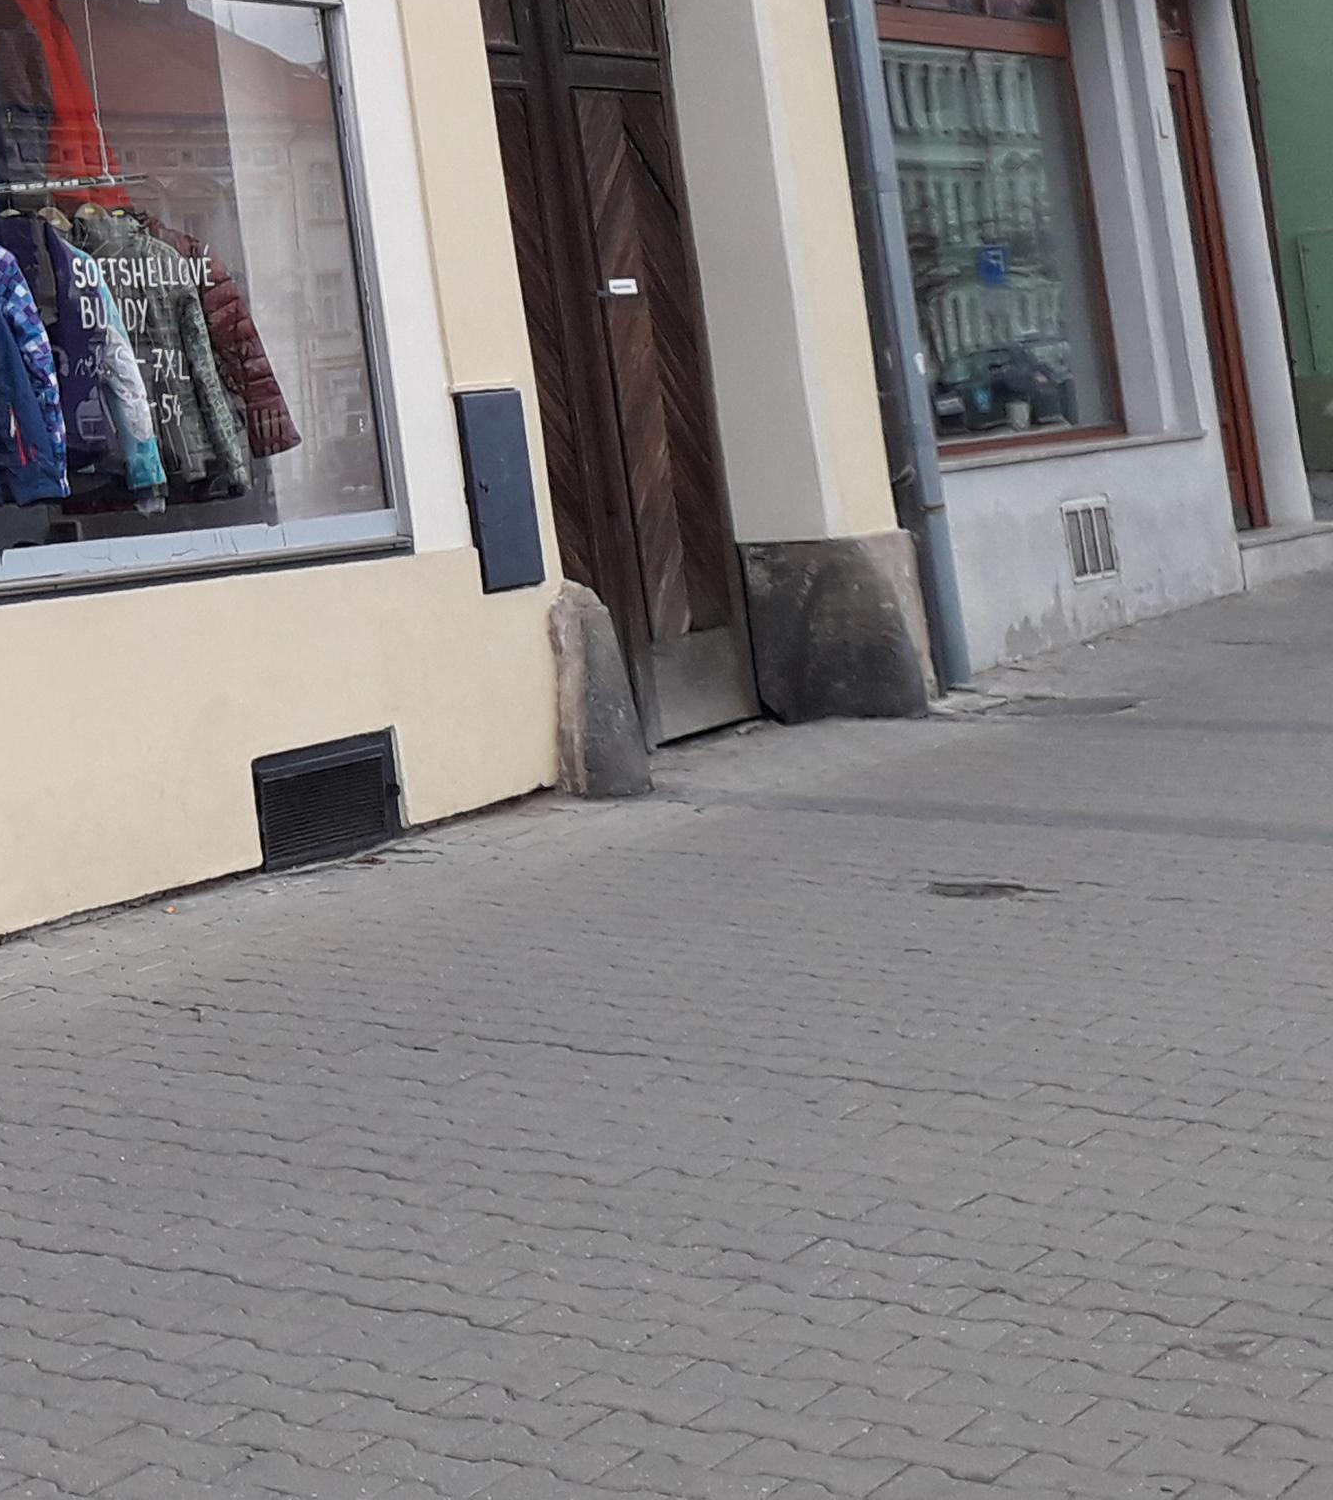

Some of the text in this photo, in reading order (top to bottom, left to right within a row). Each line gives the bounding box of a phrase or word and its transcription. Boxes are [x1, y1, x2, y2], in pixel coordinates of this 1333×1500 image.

[72, 243, 216, 289] SOFTSHELLOVÉ
[151, 348, 190, 382] 7XL
[161, 393, 183, 426] 54
